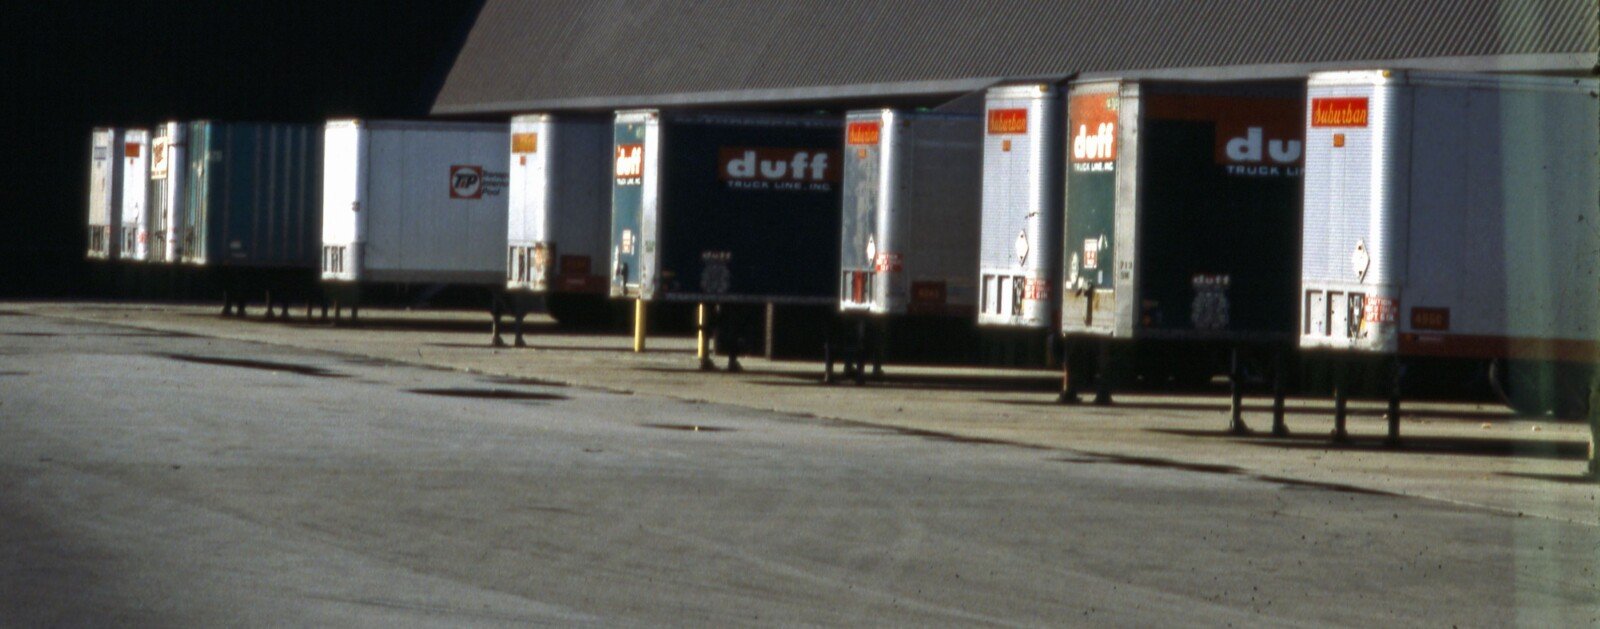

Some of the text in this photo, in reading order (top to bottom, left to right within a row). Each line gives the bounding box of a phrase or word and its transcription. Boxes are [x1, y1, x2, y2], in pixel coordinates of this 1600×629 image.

[1314, 100, 1367, 124] Suburban
[1074, 122, 1114, 159] duff
[616, 147, 641, 176] duff
[726, 150, 829, 180] duff
[1226, 165, 1280, 176] TRUCK
[727, 180, 769, 189] TRUCK
